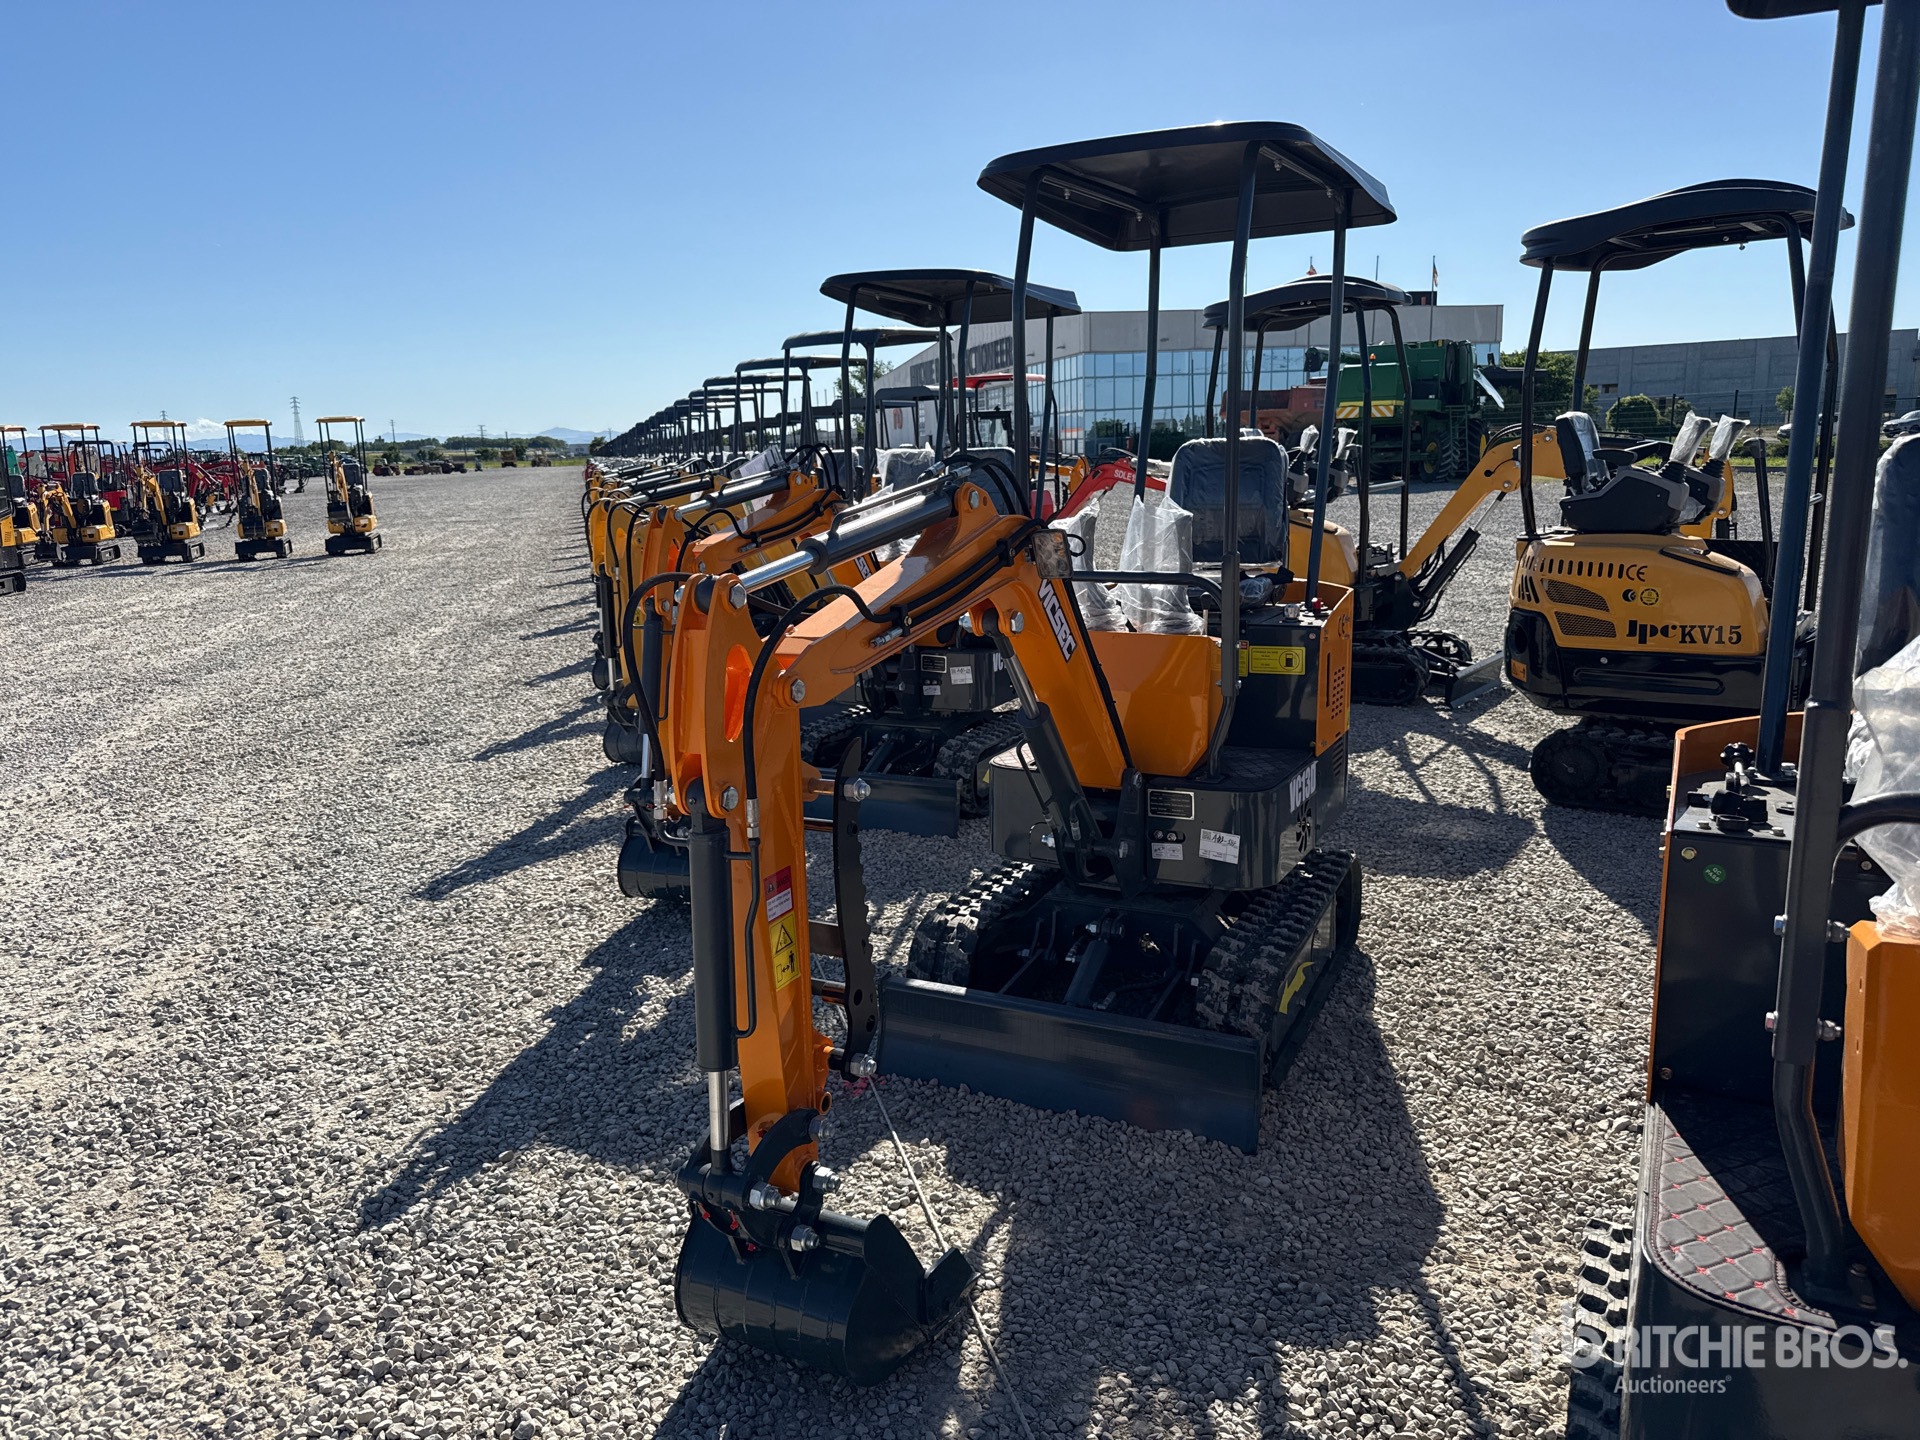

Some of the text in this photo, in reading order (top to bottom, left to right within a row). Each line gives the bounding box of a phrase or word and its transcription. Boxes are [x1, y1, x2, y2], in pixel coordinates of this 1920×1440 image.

[1626, 564, 1648, 582] CE
[1038, 579, 1077, 661] VICSEC
[1679, 625, 1742, 645] KV15
[1705, 868, 1721, 882] PASS
